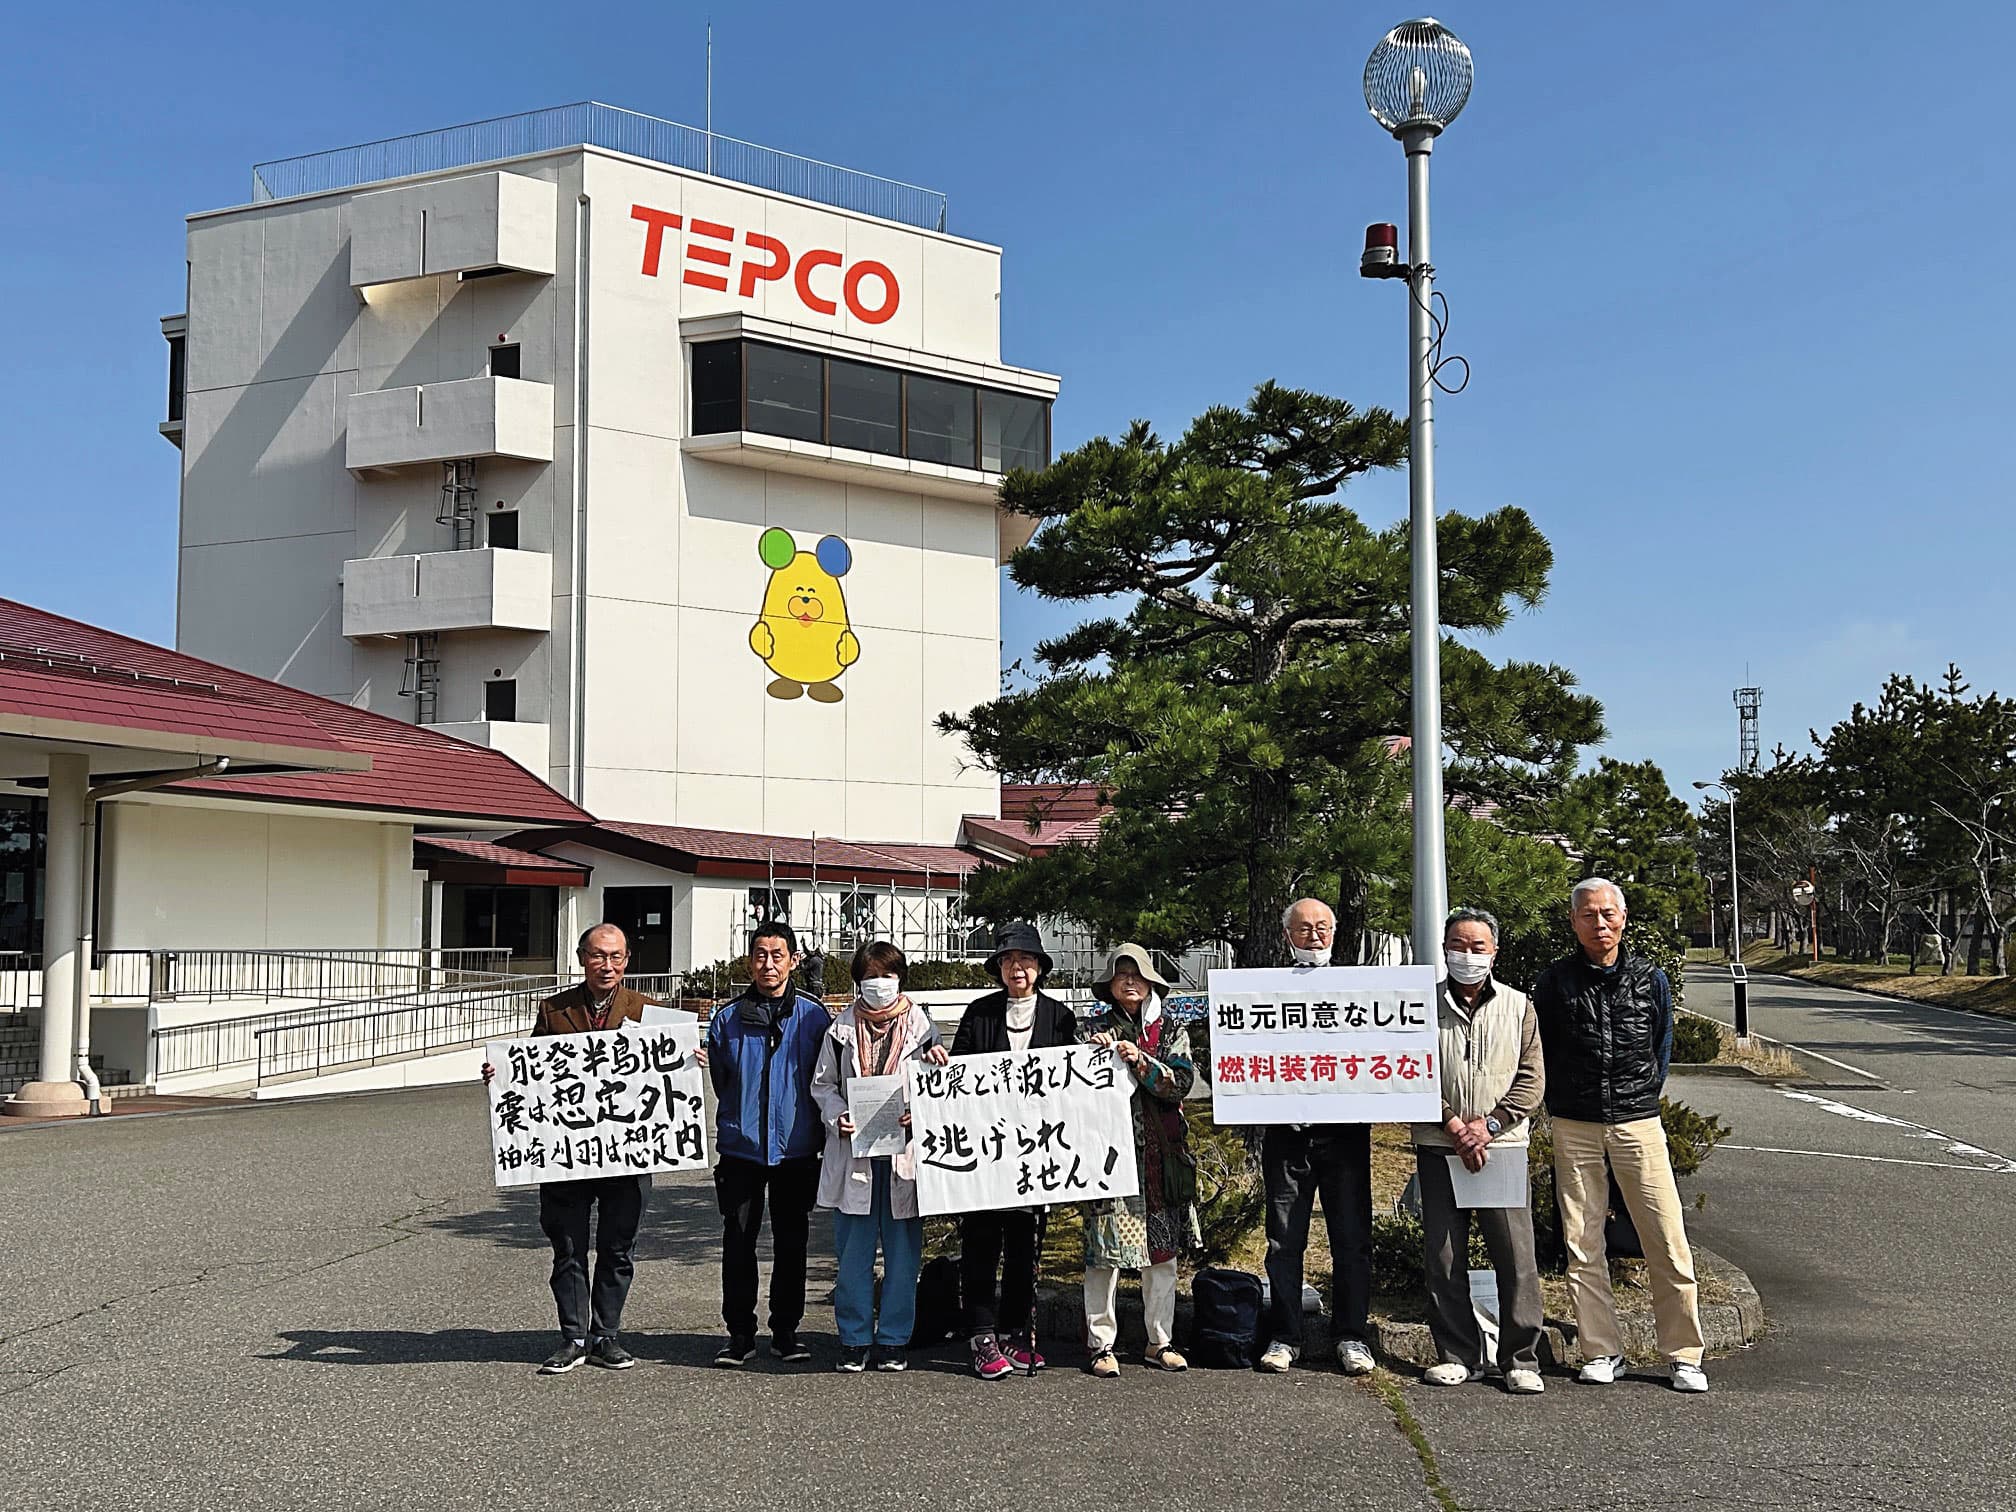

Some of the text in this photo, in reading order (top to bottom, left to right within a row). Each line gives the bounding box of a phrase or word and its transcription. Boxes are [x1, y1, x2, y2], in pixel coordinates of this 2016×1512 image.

[631, 204, 900, 325] TEPCO
[1217, 1000, 1425, 1030] 地元同意なしに
[508, 1032, 684, 1086] 能登半島地
[916, 1047, 1115, 1099] 地震と津波と大雪
[1217, 1054, 1434, 1083] 燃料装荷するな!
[495, 1074, 702, 1135] 震は想定外?
[498, 1121, 704, 1170] 柏崎刈羽は想定内
[921, 1117, 1071, 1172] 逃げられ
[1016, 1146, 1119, 1195] ません!
